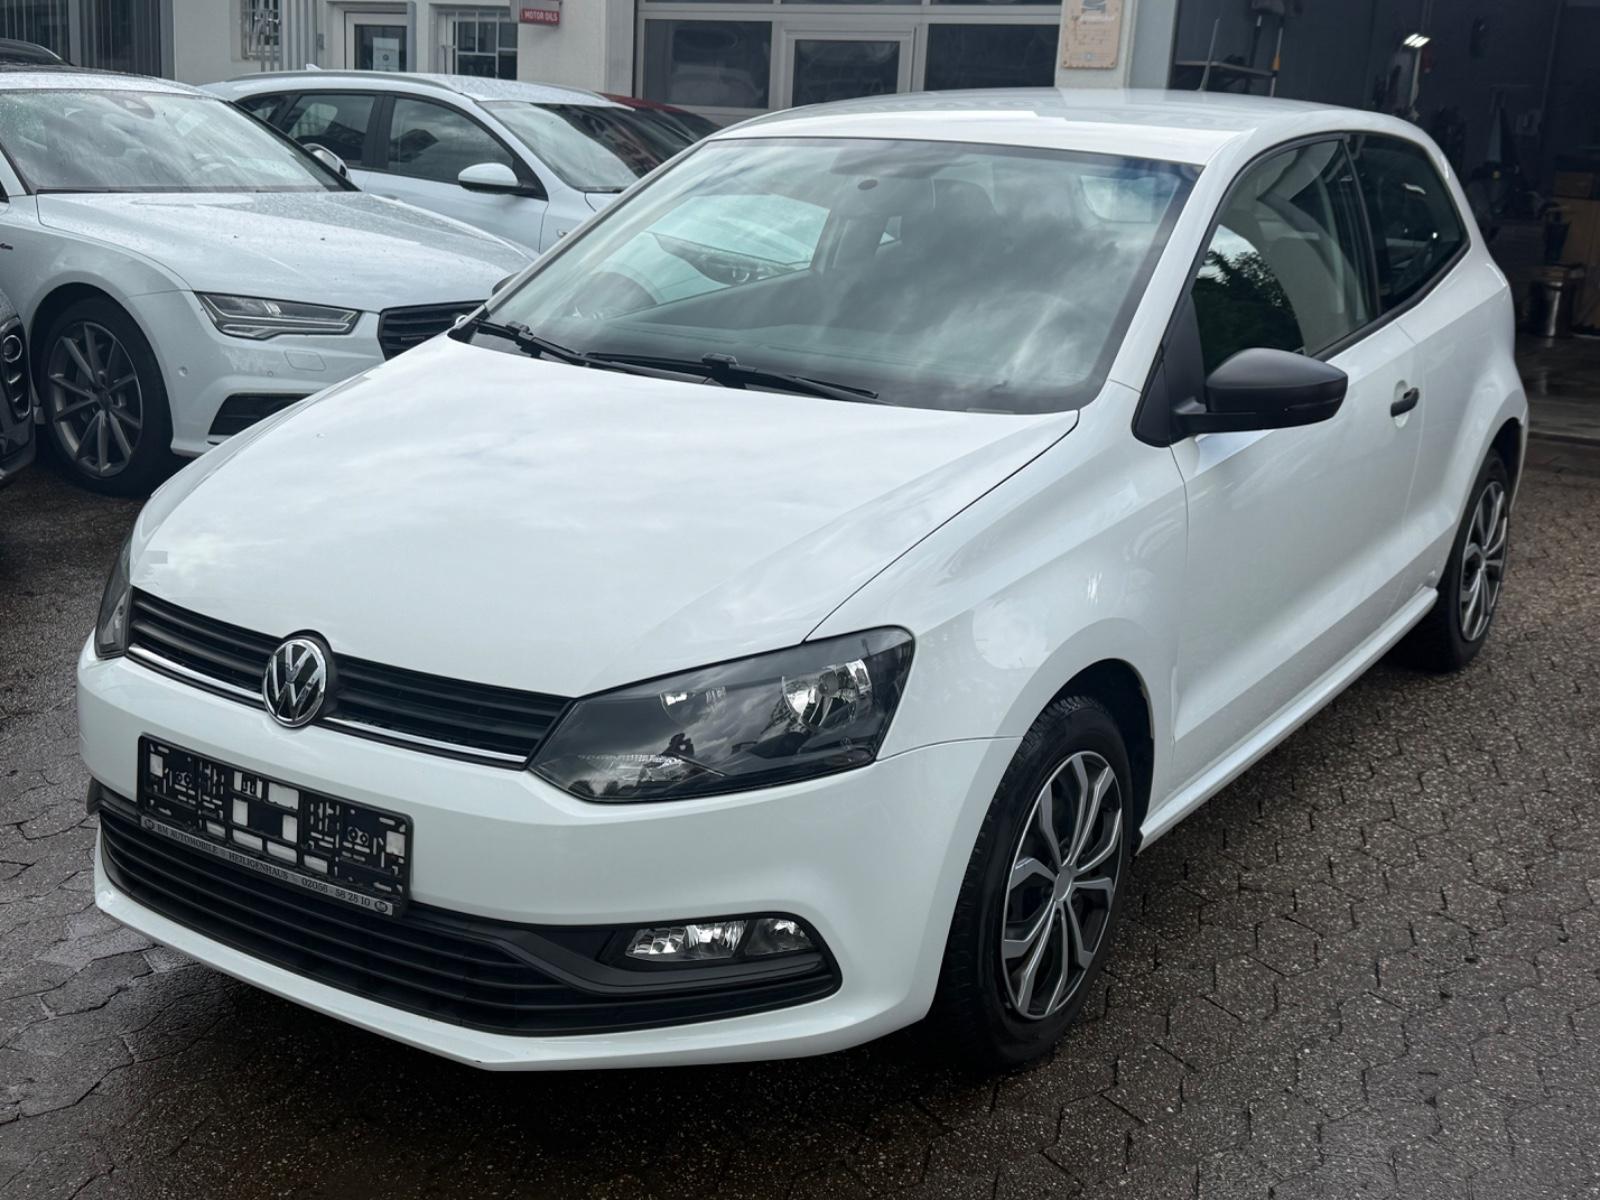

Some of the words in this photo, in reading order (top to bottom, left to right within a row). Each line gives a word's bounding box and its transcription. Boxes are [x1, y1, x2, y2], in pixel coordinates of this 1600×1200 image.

[524, 10, 544, 20] MOTOR
[544, 12, 558, 21] OILS
[170, 828, 217, 853] AUTOMOBILE
[228, 852, 288, 881] HEILIGENHAUS
